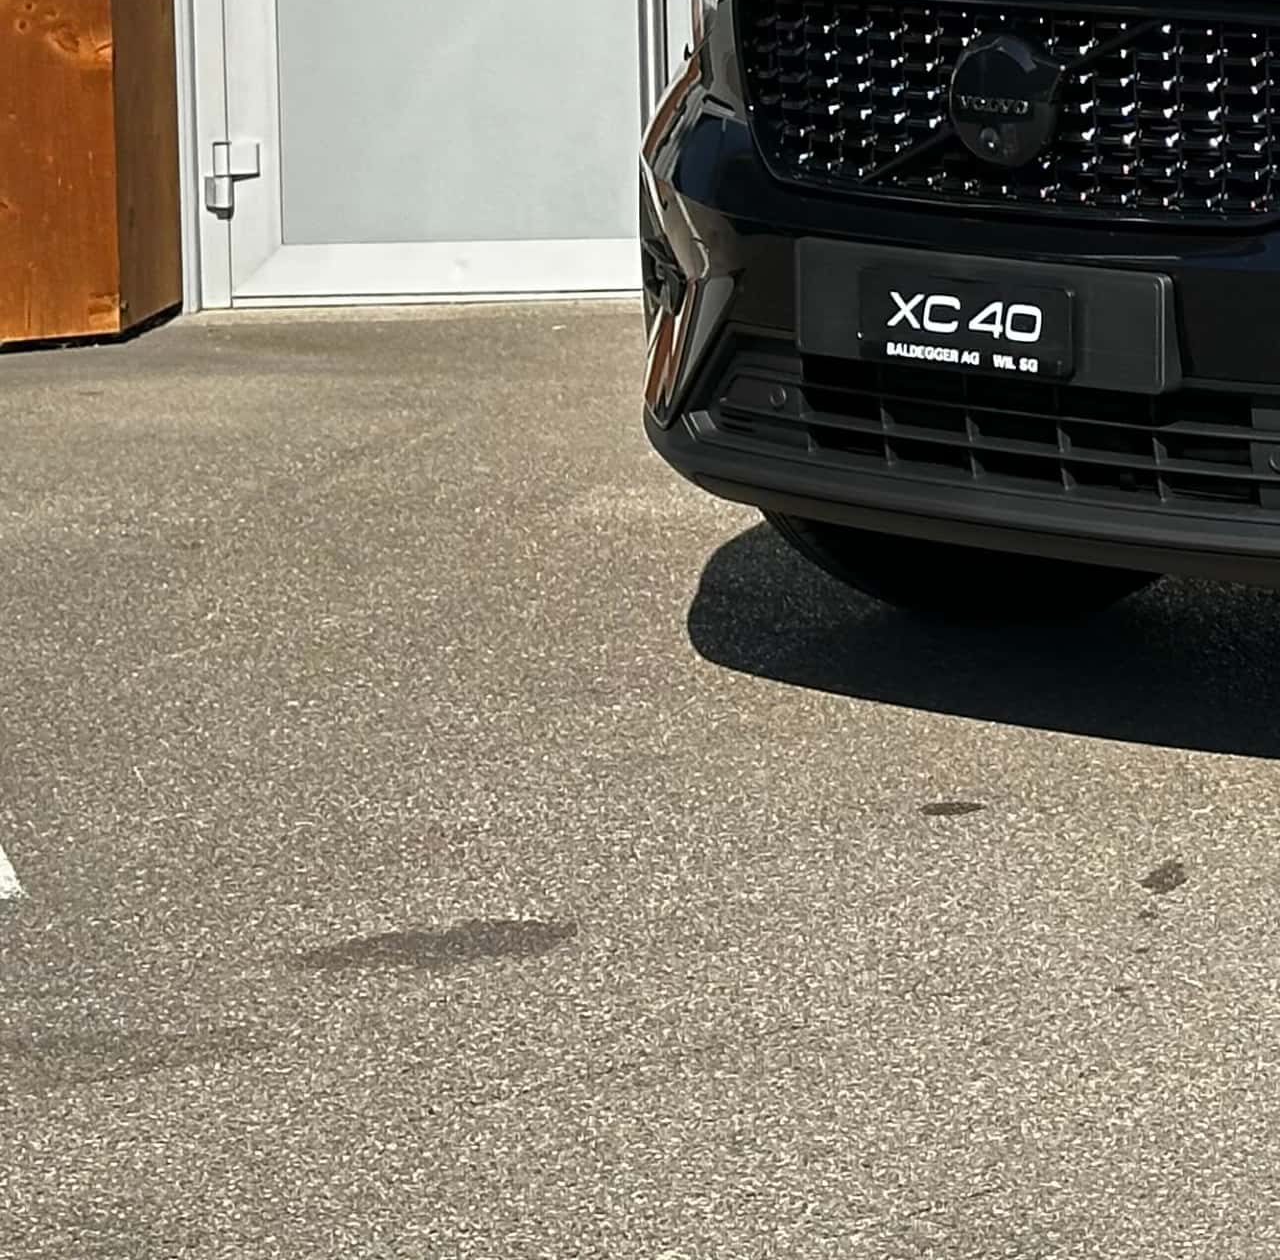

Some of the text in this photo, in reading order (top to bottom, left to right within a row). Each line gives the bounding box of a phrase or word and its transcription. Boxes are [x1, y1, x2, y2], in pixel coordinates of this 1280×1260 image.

[887, 291, 1042, 342] XC 40
[886, 342, 1039, 373] BALDEGGER AG WIL SG
